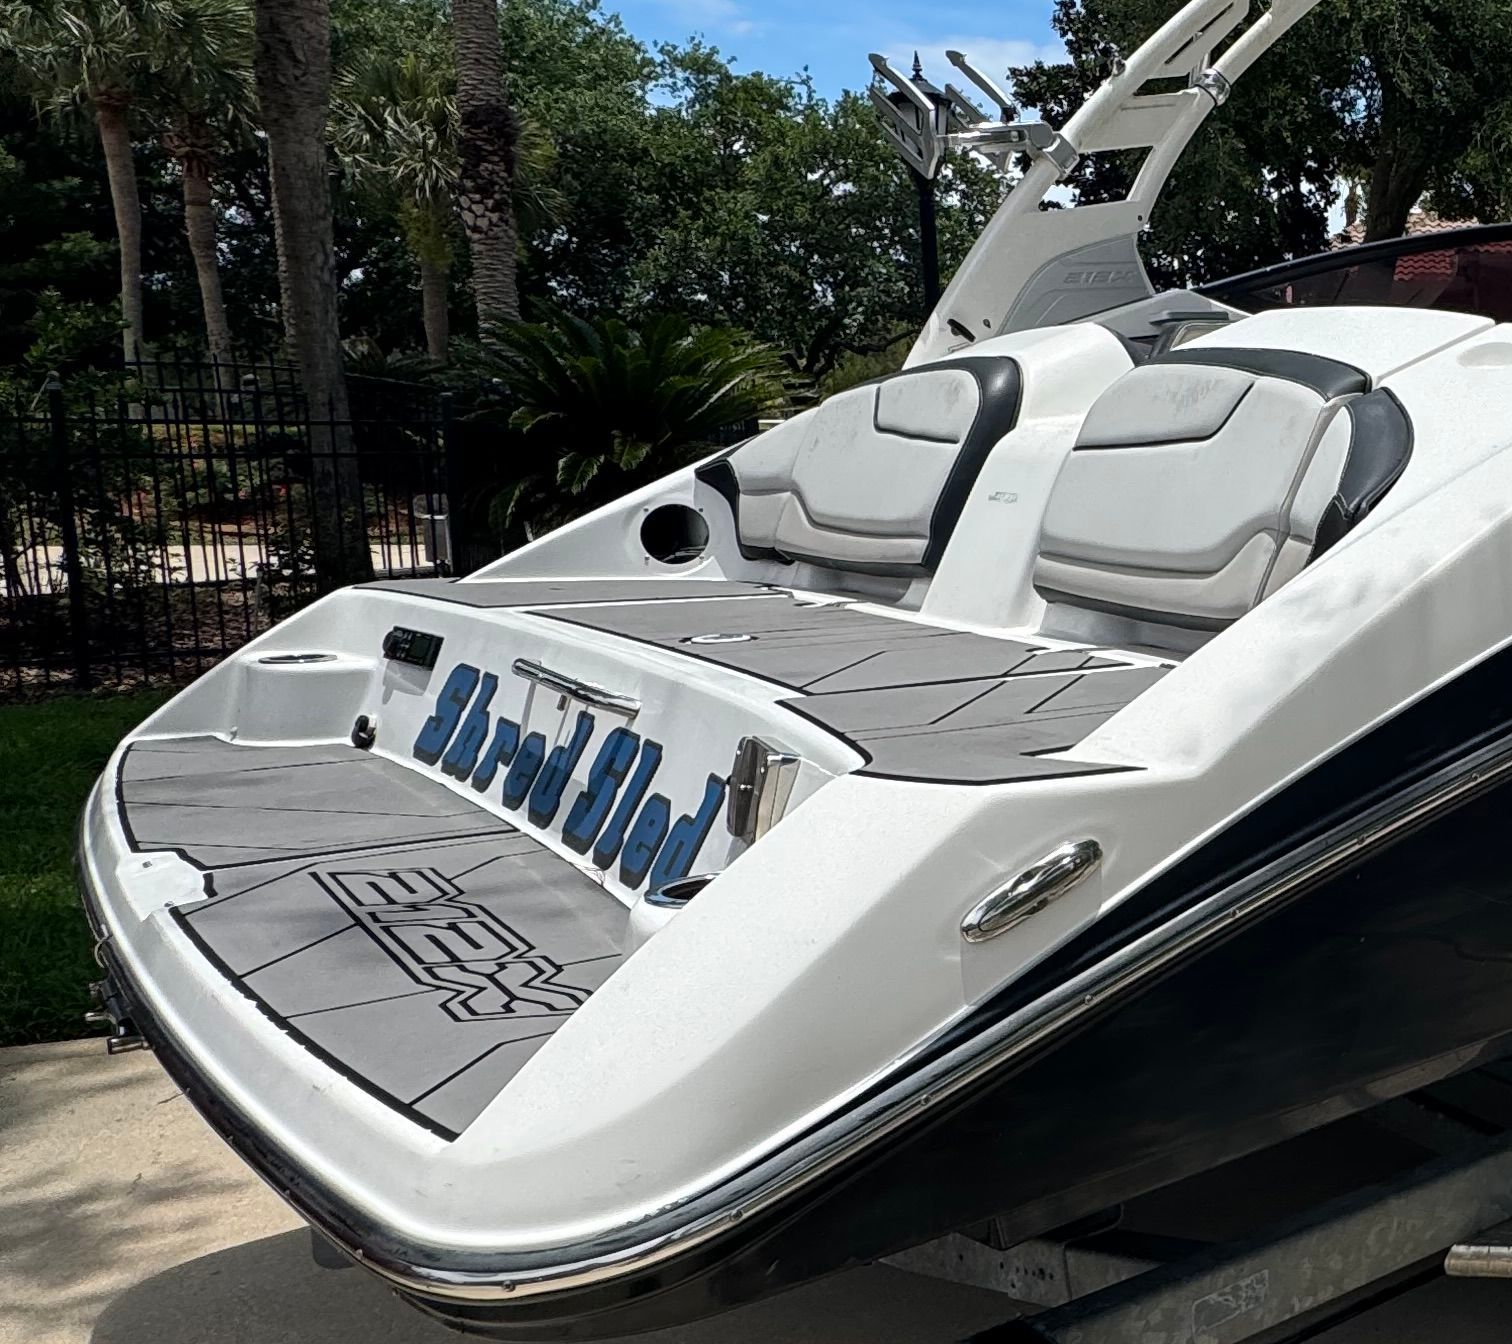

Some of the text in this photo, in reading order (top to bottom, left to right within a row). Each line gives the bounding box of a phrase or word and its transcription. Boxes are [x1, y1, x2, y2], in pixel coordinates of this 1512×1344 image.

[412, 662, 727, 894] Shred Sled
[312, 866, 592, 1022] 212X
